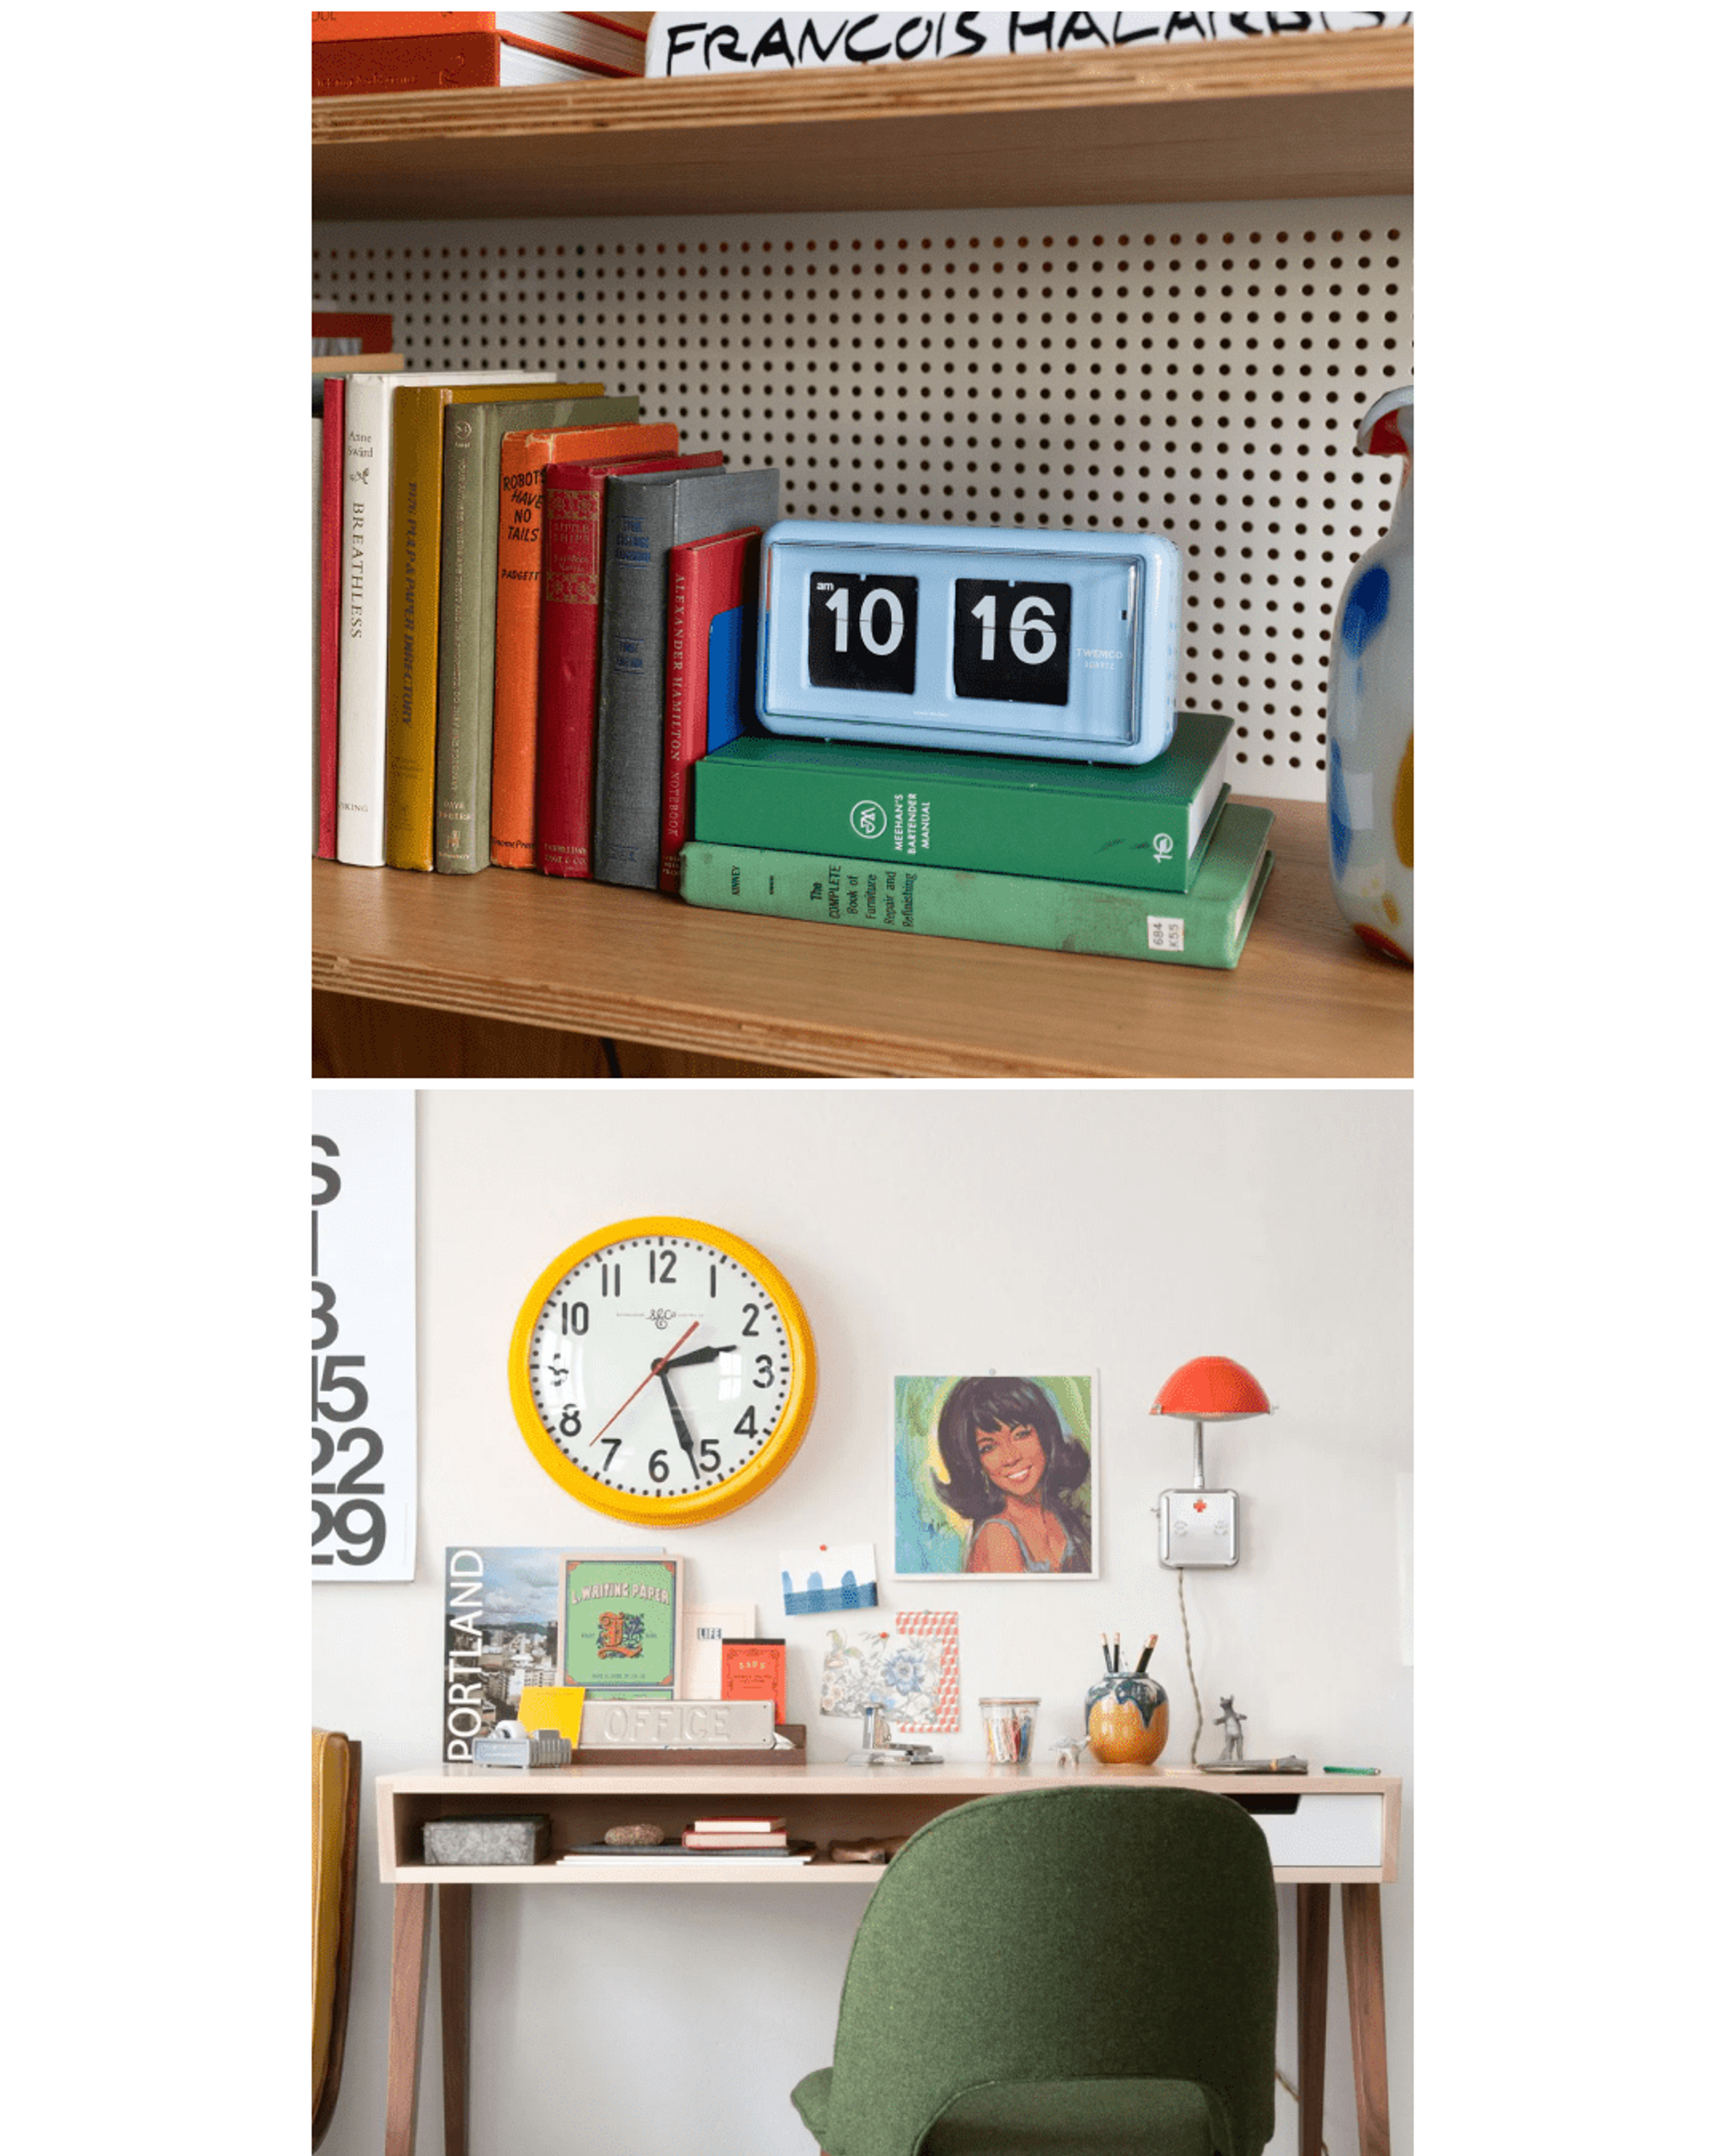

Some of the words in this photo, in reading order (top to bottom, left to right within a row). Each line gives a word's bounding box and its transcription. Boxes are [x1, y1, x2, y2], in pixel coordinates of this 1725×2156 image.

[667, 12, 987, 77] FRANCOIS
[503, 470, 546, 491] ROBOTS
[511, 490, 544, 509] HAVE
[514, 508, 531, 524] NO
[507, 527, 540, 542] TAILS
[351, 502, 365, 639] BREATHLESS
[501, 569, 540, 581] PADGETT
[817, 581, 834, 591] am
[403, 578, 416, 631] PAPER
[673, 573, 685, 671] ALEXANDER
[826, 588, 905, 656] 10
[971, 595, 1057, 665] 16
[402, 633, 415, 725] DIRECTORY
[671, 677, 683, 762] HAMILTON
[668, 771, 680, 837] NOTEBOOK
[894, 794, 904, 851] MEEHAN'S
[907, 793, 917, 855] BARTENDER
[920, 801, 930, 849] MANUAL
[810, 882, 823, 901] The
[828, 864, 841, 919] COMPLETE
[848, 875, 859, 889] of
[866, 873, 877, 919] Furniture
[885, 870, 897, 891] and
[846, 892, 858, 915] Book
[883, 894, 896, 926] Repair
[902, 873, 917, 928] Refinishing
[1153, 922, 1164, 946] 684
[602, 1263, 620, 1297] 11
[650, 1250, 677, 1284] 12
[710, 1264, 717, 1298] 1
[562, 1301, 589, 1336] 10
[742, 1303, 760, 1337] 2
[752, 1354, 775, 1389] 3
[559, 1403, 583, 1437] 8
[733, 1405, 759, 1439] 4
[601, 1438, 622, 1472] 7
[648, 1449, 670, 1483] 6
[699, 1438, 721, 1473] 5
[581, 1582, 629, 1600] WRITING
[631, 1583, 670, 1605] PAPER
[447, 1550, 484, 1760] PORTLAND
[604, 1706, 731, 1744] OFFICE
